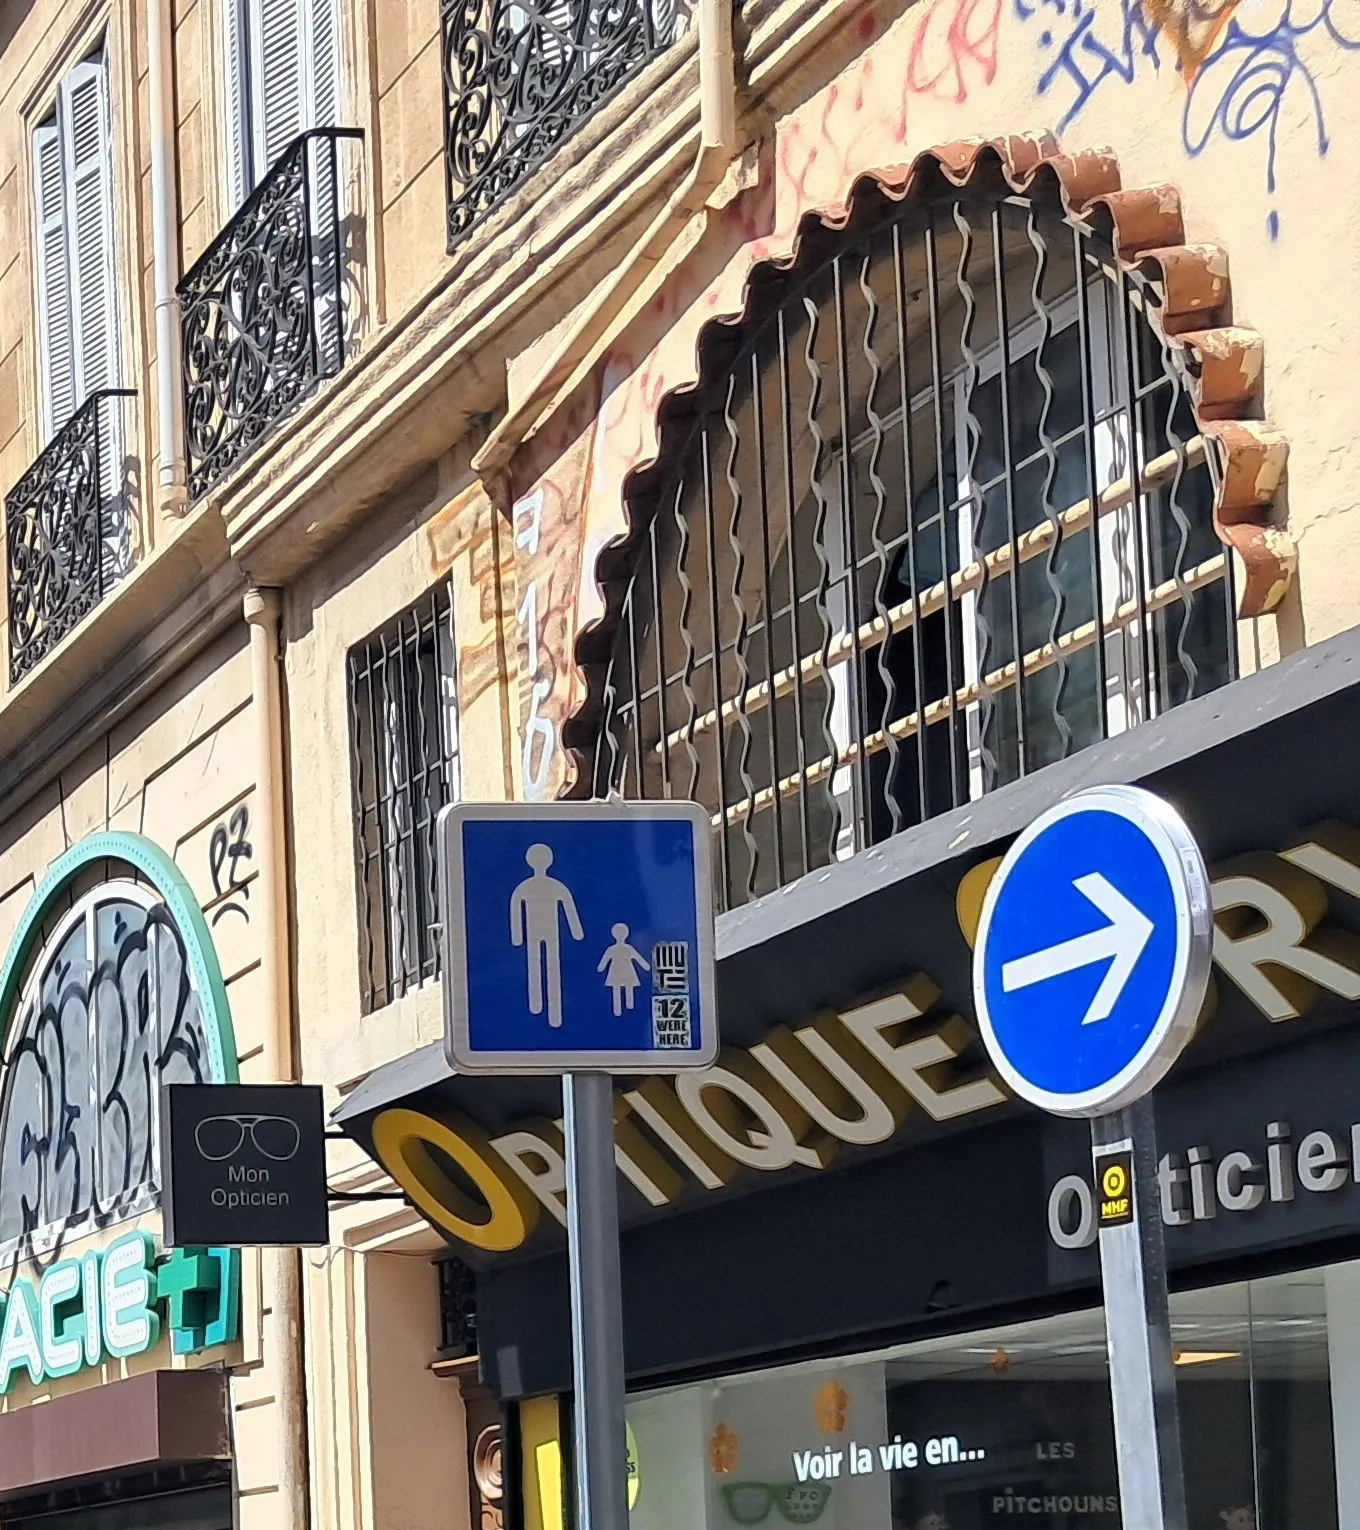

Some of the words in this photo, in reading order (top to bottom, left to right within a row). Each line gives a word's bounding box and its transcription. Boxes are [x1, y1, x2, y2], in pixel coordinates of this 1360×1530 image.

[658, 999, 684, 1018] 12
[228, 1164, 270, 1183] Mon
[1048, 1121, 1360, 1249] Oticie
[211, 1187, 289, 1210] Opticien
[793, 1446, 842, 1482] Voir
[849, 1441, 873, 1475] la
[879, 1435, 918, 1470] vie
[925, 1435, 985, 1466] en...
[1036, 1442, 1075, 1459] LES
